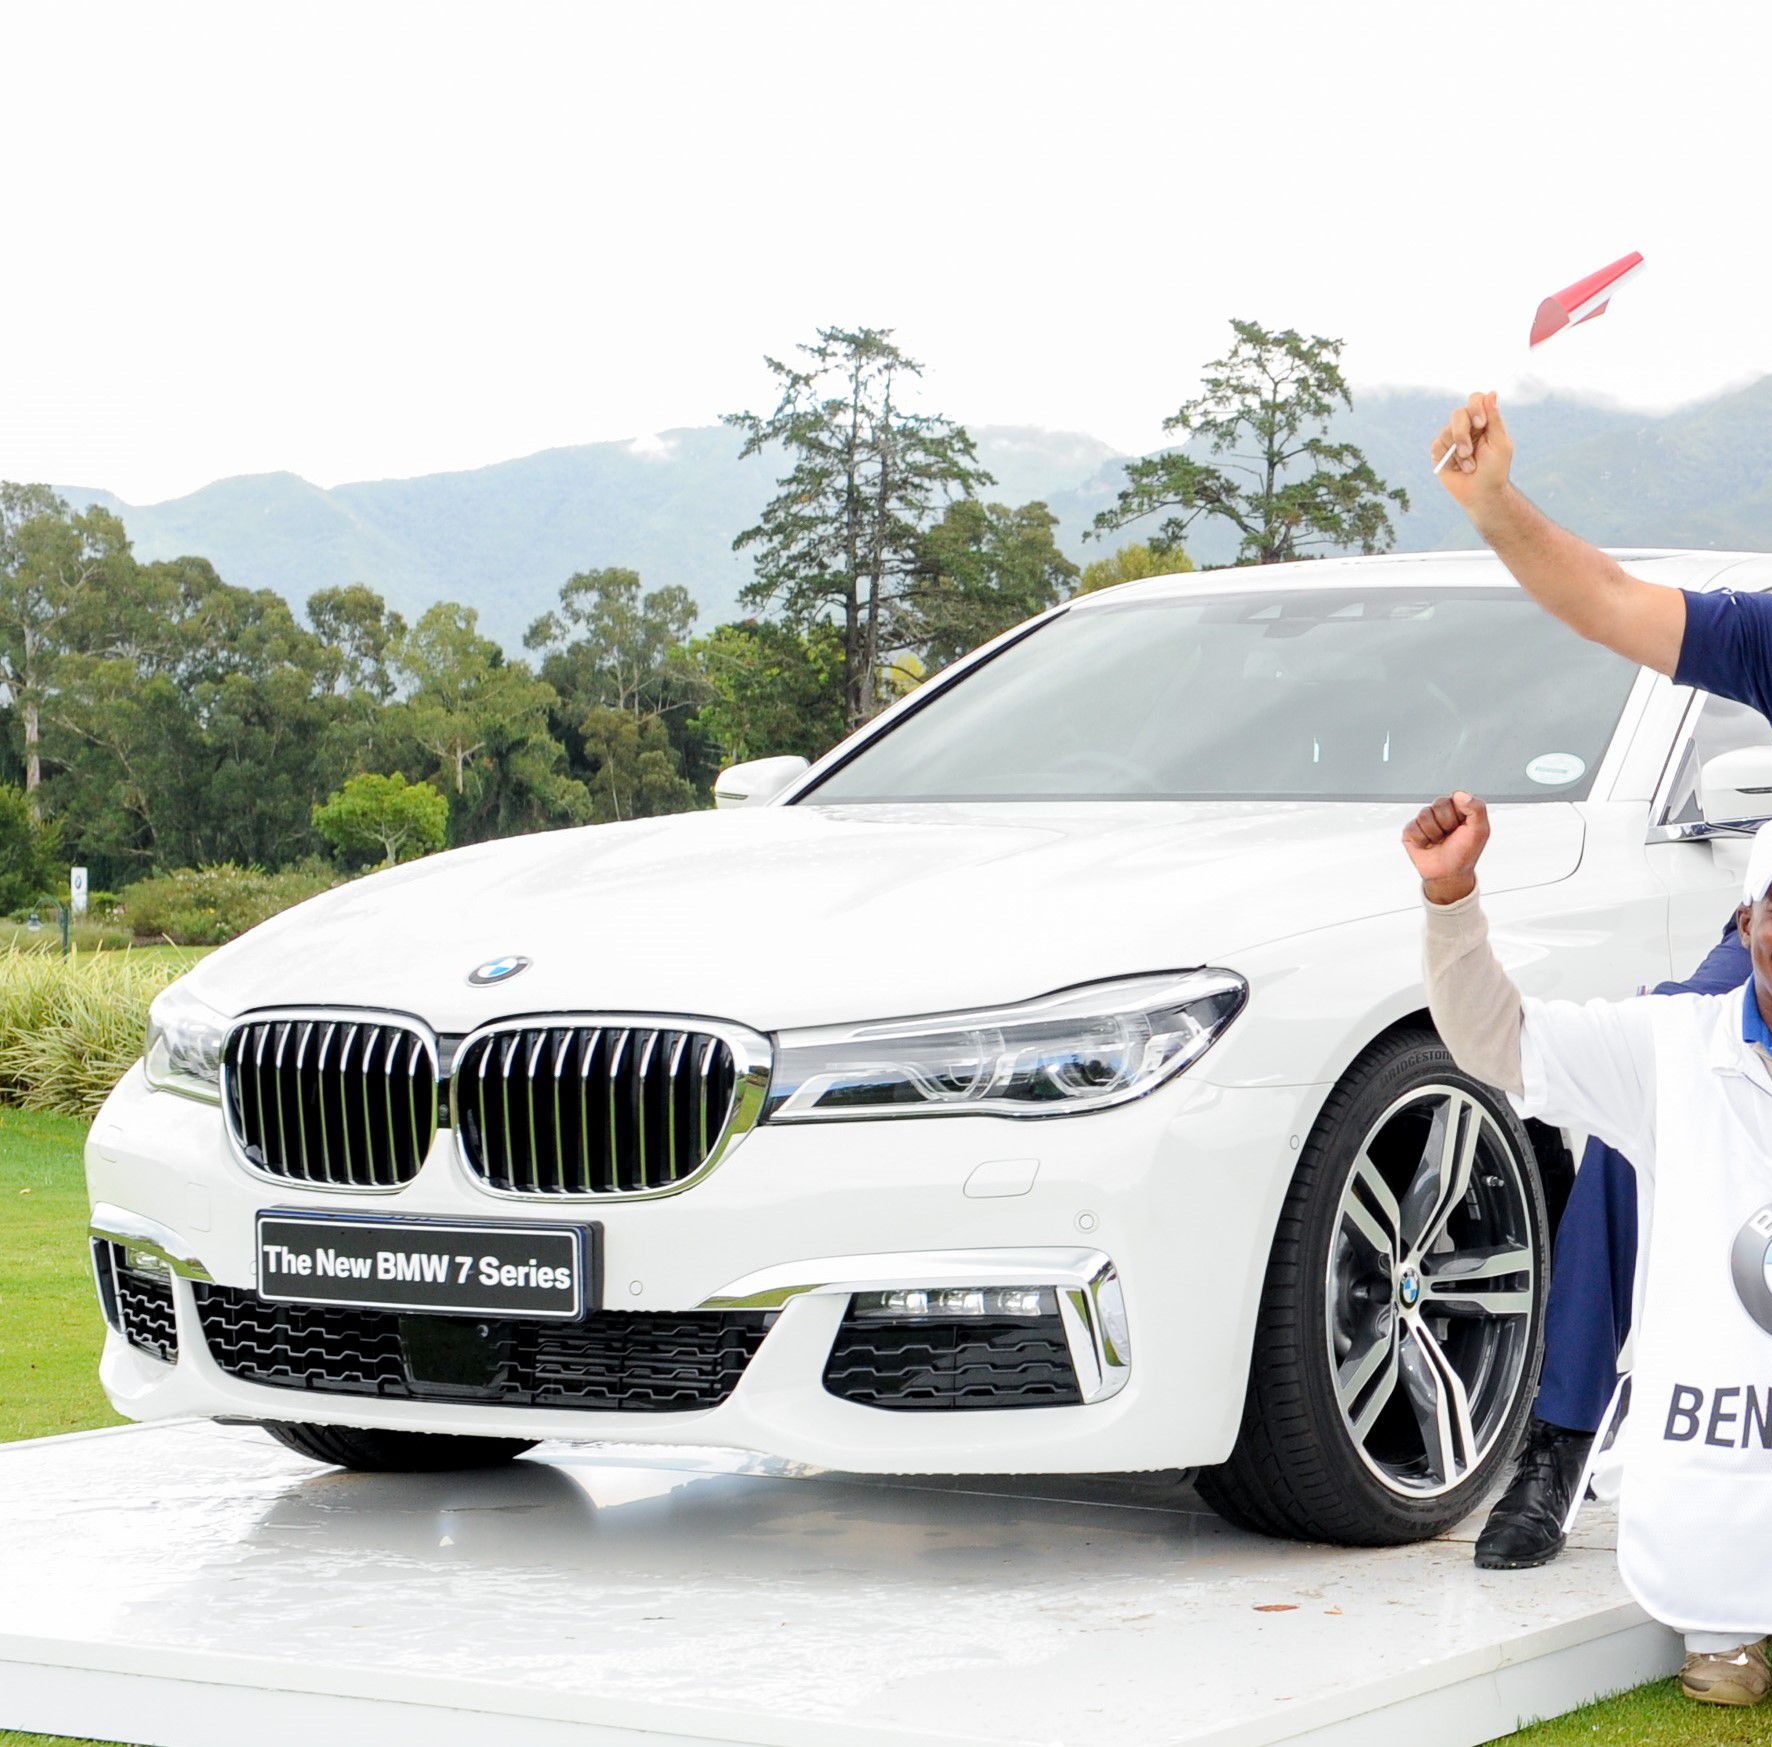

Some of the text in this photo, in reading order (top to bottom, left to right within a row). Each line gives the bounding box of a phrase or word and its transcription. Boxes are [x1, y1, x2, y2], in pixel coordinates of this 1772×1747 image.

[262, 1244, 573, 1290] The New BMW 7 Series
